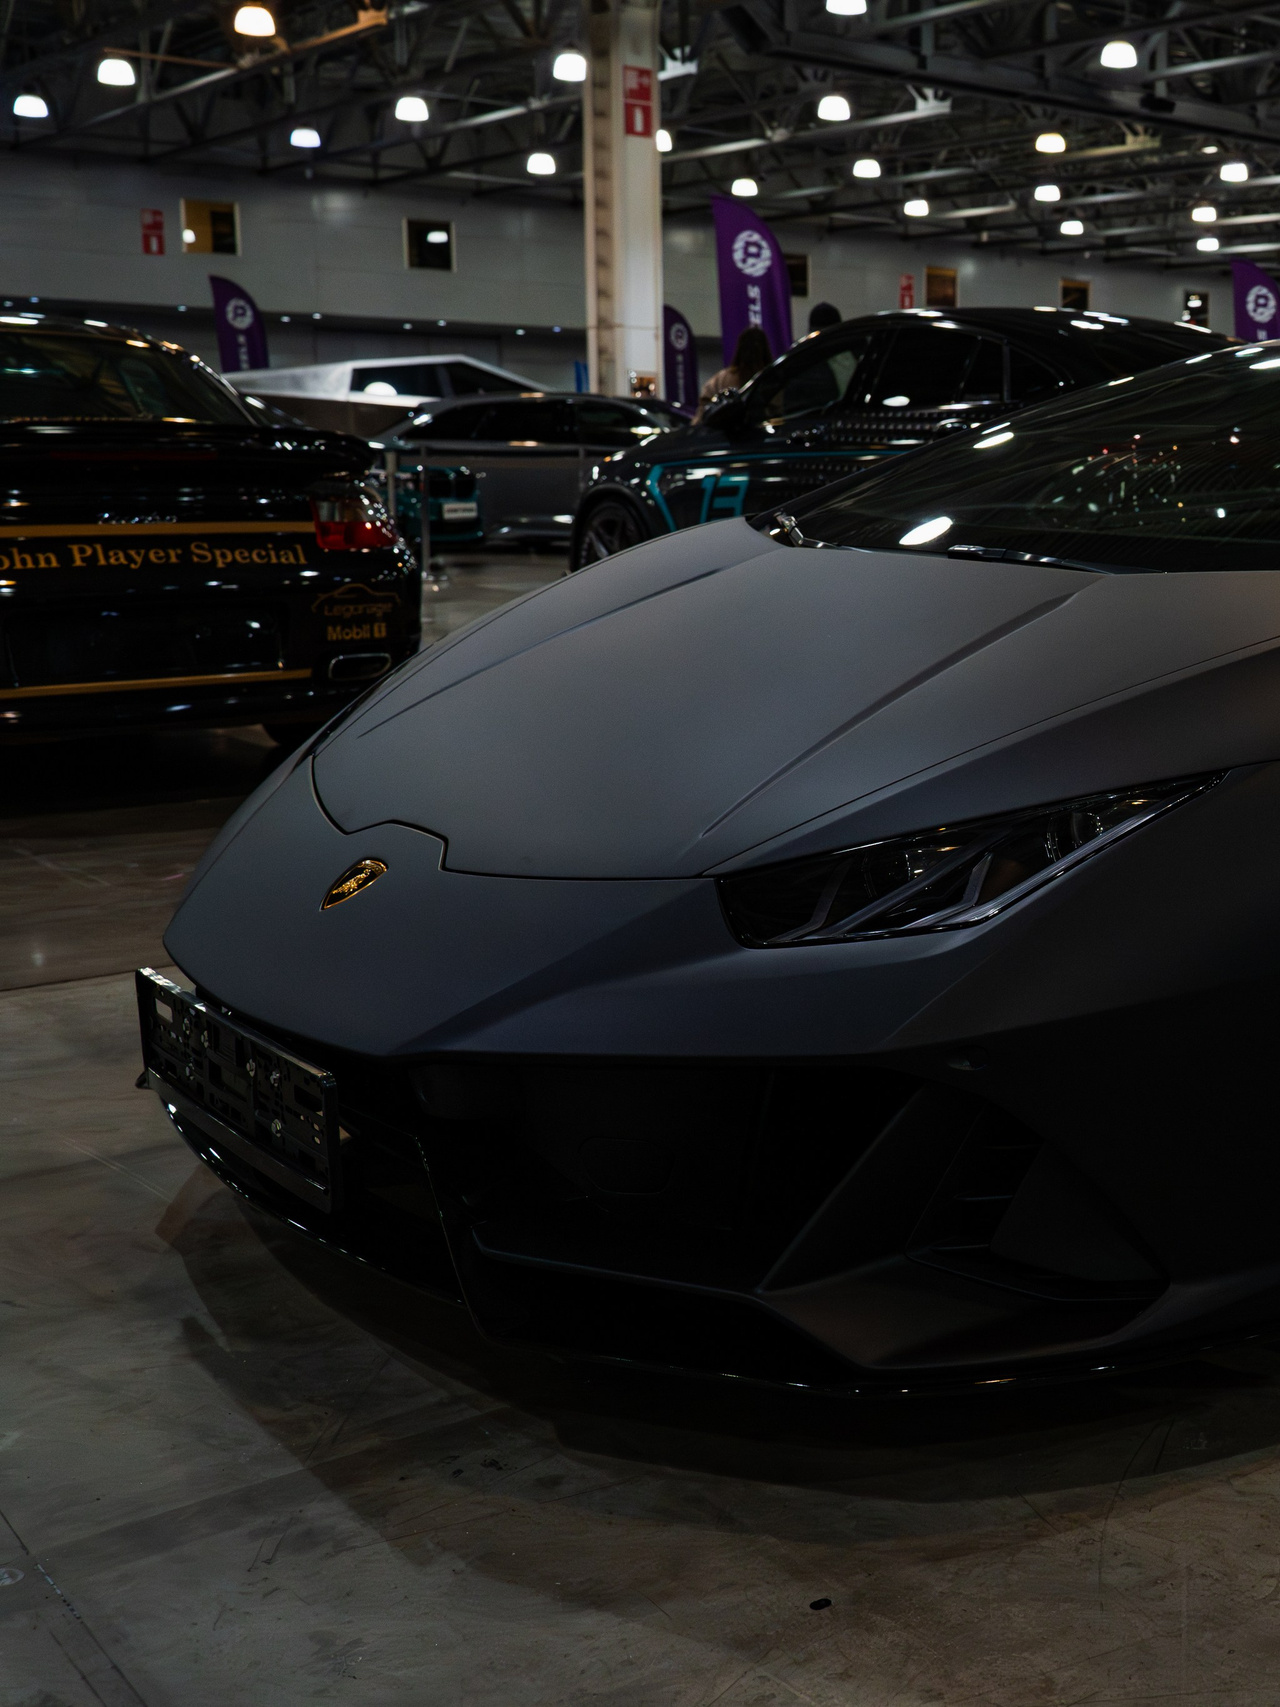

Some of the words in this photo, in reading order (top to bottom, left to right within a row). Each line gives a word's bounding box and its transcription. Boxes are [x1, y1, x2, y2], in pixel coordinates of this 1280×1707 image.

[66, 543, 184, 570] Player
[189, 540, 309, 569] Special
[326, 623, 371, 641] Mobil
